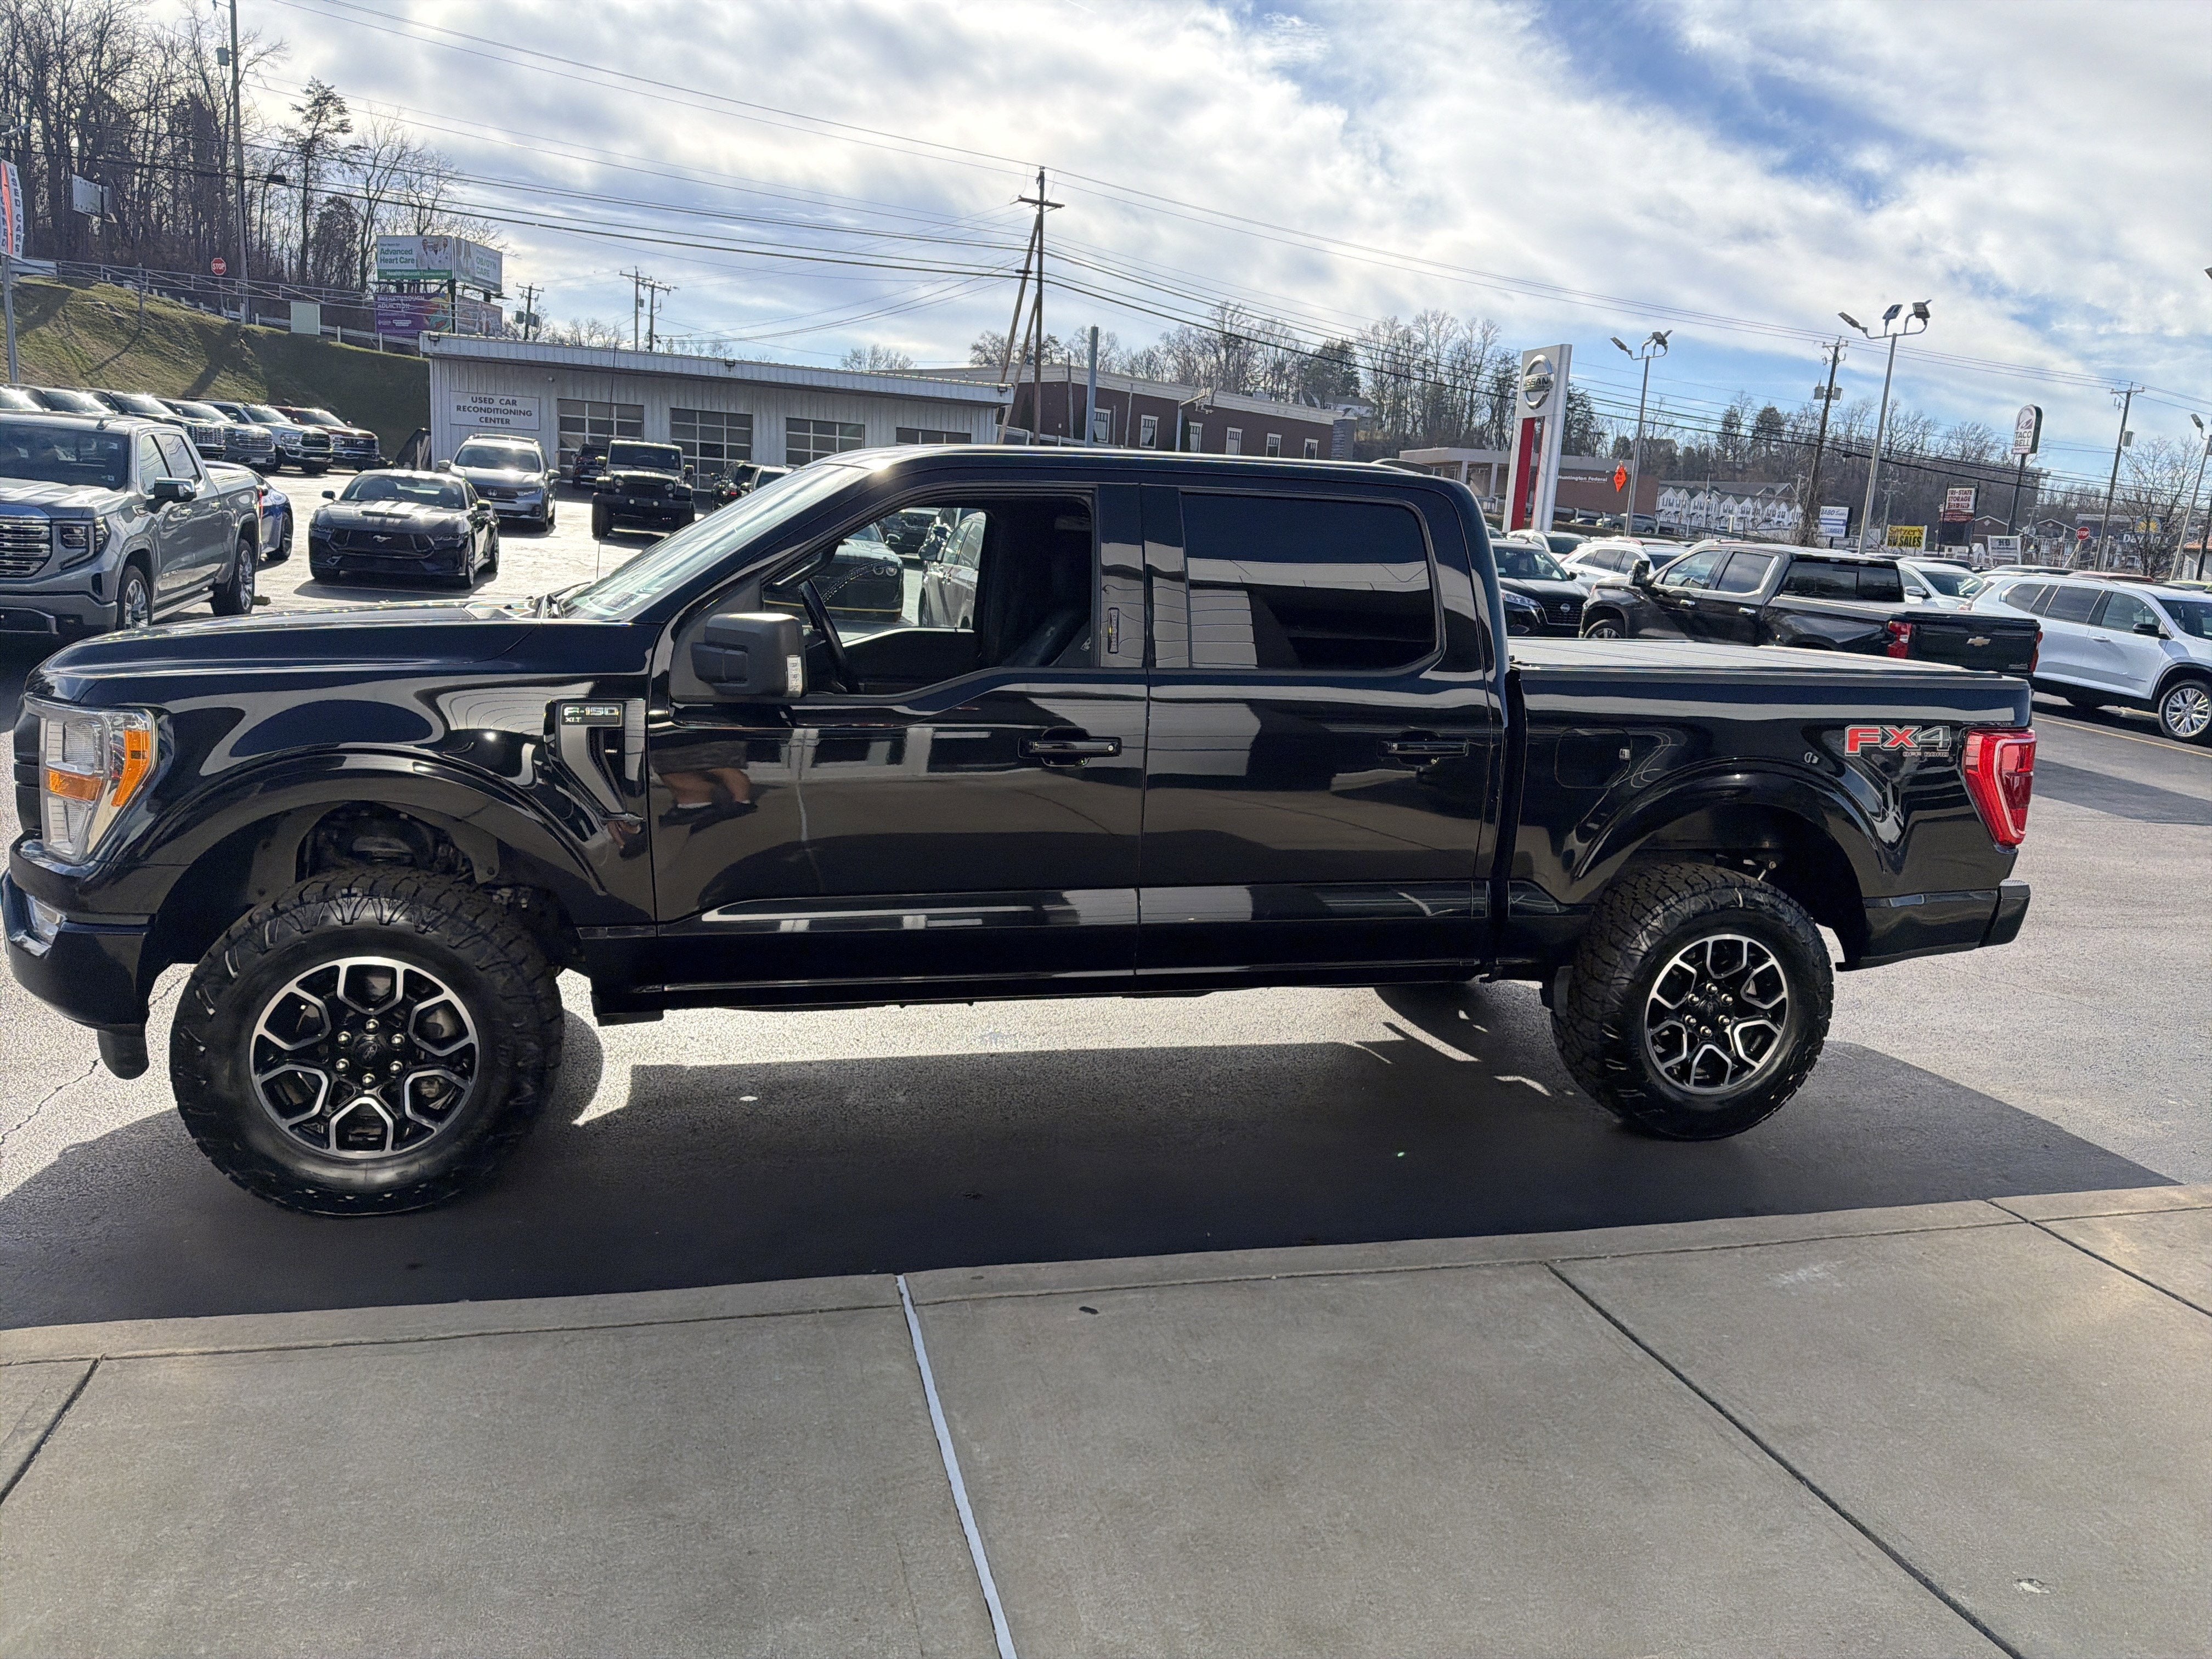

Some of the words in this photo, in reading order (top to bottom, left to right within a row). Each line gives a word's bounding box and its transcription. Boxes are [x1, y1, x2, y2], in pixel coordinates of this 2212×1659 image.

[9, 167, 20, 208] USED
[476, 256, 496, 270] OB/GYN
[476, 266, 490, 277] CARE
[471, 396, 494, 404] USED
[499, 398, 517, 407] CAR
[456, 405, 533, 417] RECONDITIONING
[479, 416, 511, 425] CENTER
[2015, 431, 2032, 439] TACO
[1887, 535, 1898, 546] RV
[1899, 535, 1922, 548] SALES
[564, 707, 619, 716] F-150
[1845, 725, 1951, 757] FX4
